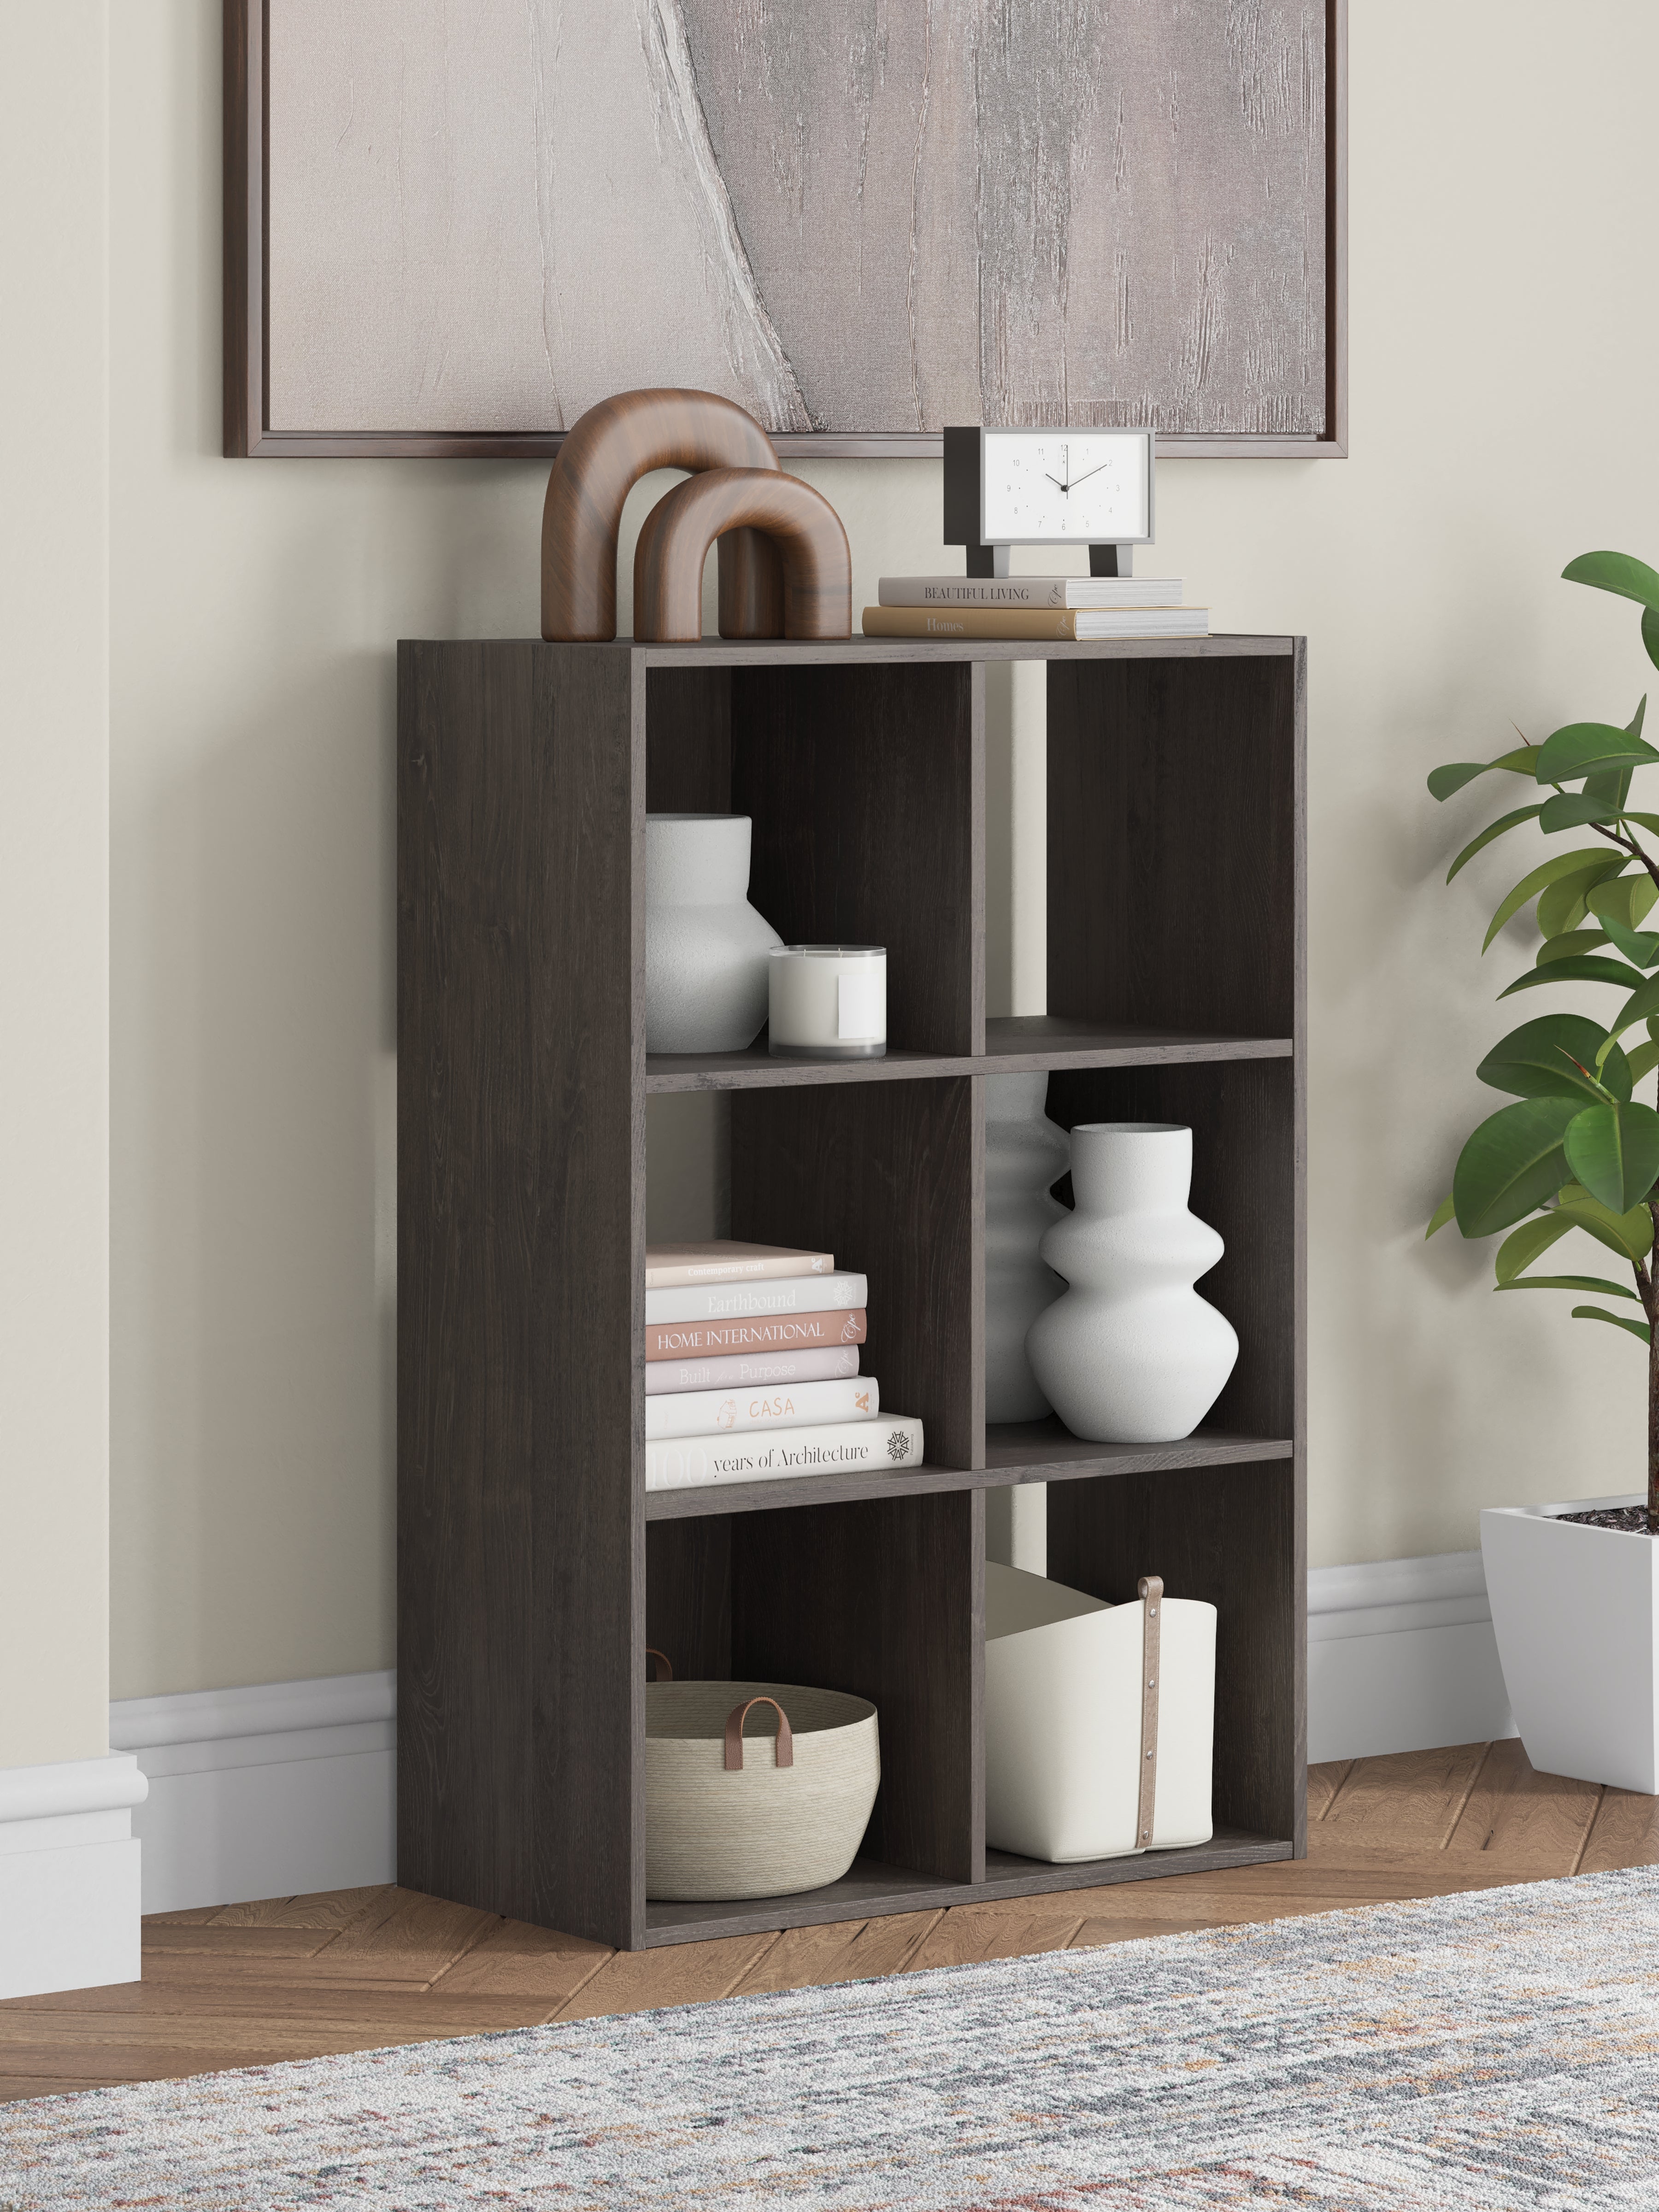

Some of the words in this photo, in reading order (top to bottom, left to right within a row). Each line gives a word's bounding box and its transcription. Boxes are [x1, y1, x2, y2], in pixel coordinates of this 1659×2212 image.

[924, 587, 988, 600] BEAUTIFUL
[991, 588, 1029, 600] LIVING
[926, 618, 964, 631] Homes
[688, 1265, 744, 1276] Contemporary
[746, 1263, 765, 1272] craft
[707, 1288, 796, 1313] Earthbound
[658, 1331, 702, 1349] HOME
[706, 1322, 825, 1346] INTERNATIONAL
[679, 1367, 711, 1384] Built
[740, 1363, 796, 1381] Purpose
[749, 1397, 795, 1418] CASA
[650, 1447, 707, 1488] 100
[713, 1456, 753, 1478] years
[759, 1448, 775, 1467] of
[777, 1444, 869, 1467] Architecture
